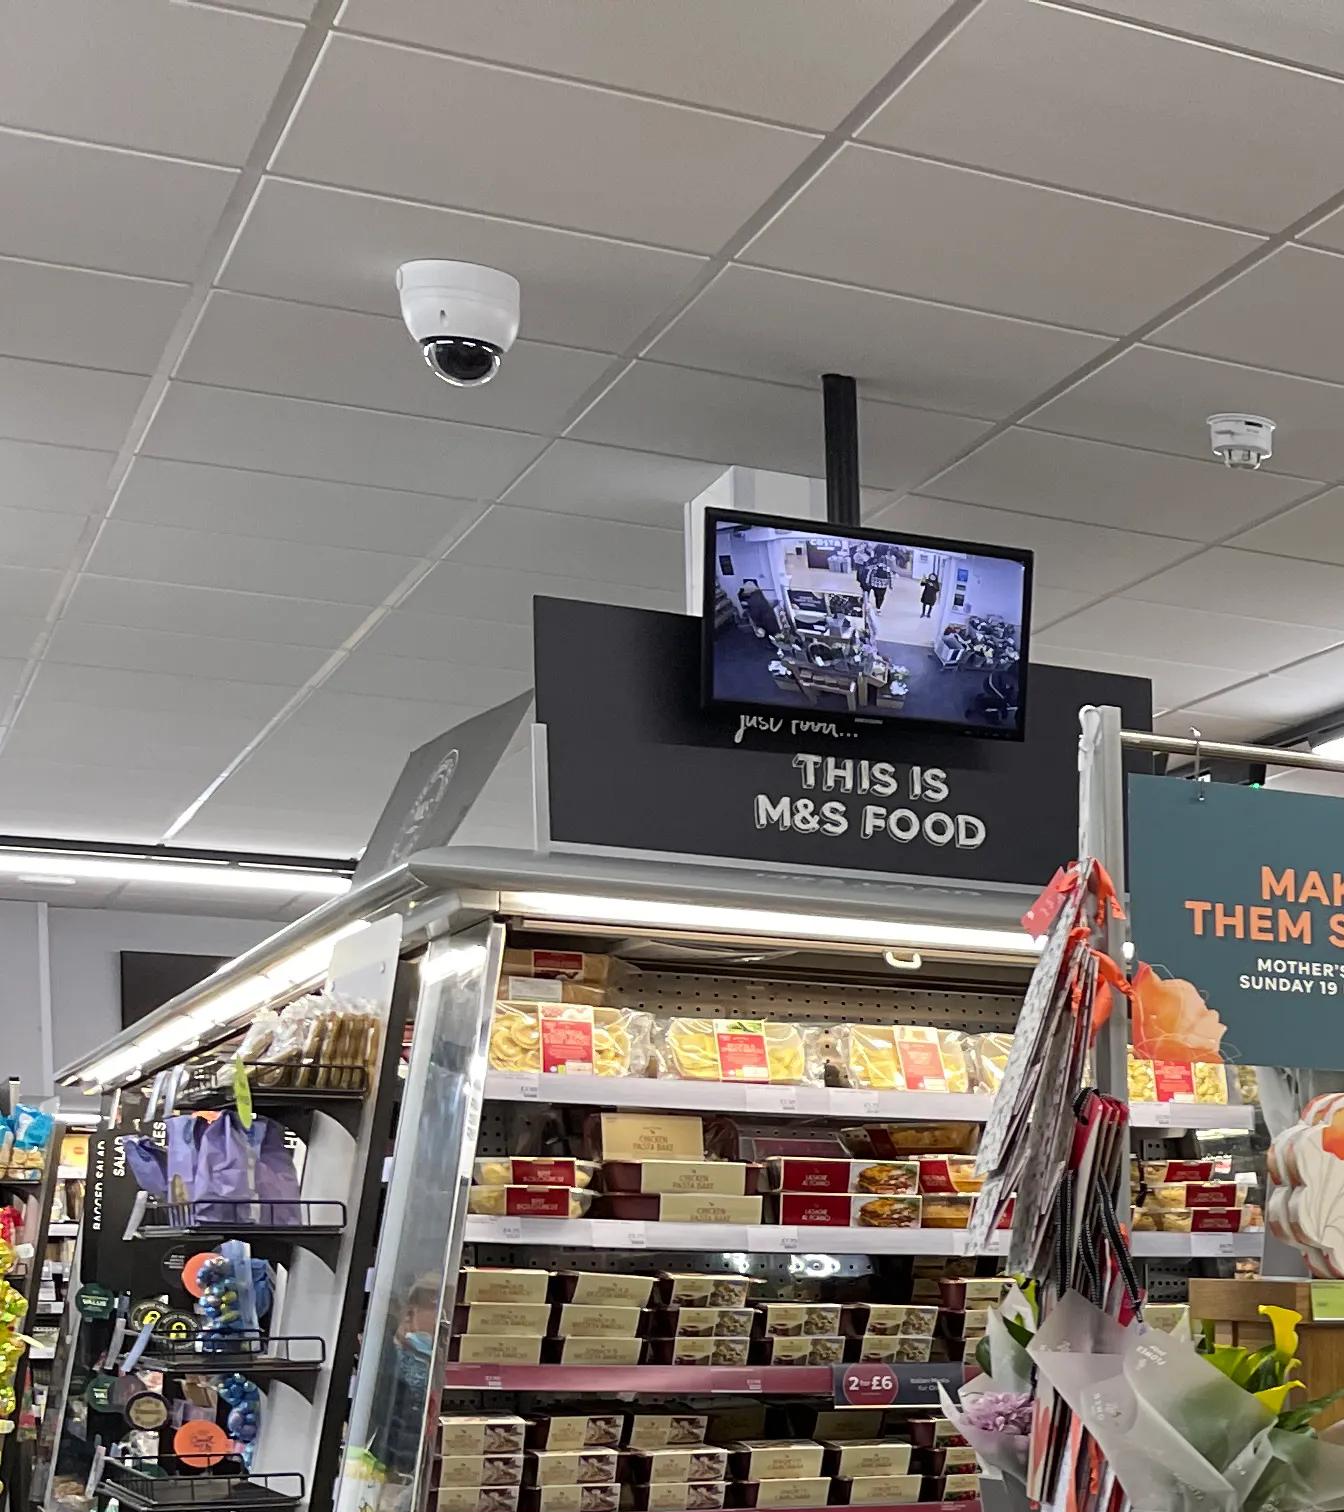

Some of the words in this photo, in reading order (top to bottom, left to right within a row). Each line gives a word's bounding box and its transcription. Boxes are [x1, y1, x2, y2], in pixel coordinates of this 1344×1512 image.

[792, 753, 898, 798] THIS
[909, 765, 949, 803] IS
[753, 794, 848, 837] M&S
[860, 804, 986, 849] FOOD
[1184, 900, 1312, 944] THEM
[1239, 975, 1314, 994] SUNDAY
[1320, 980, 1338, 996] 19
[848, 1376, 859, 1391] 2
[871, 1375, 893, 1391] £6
